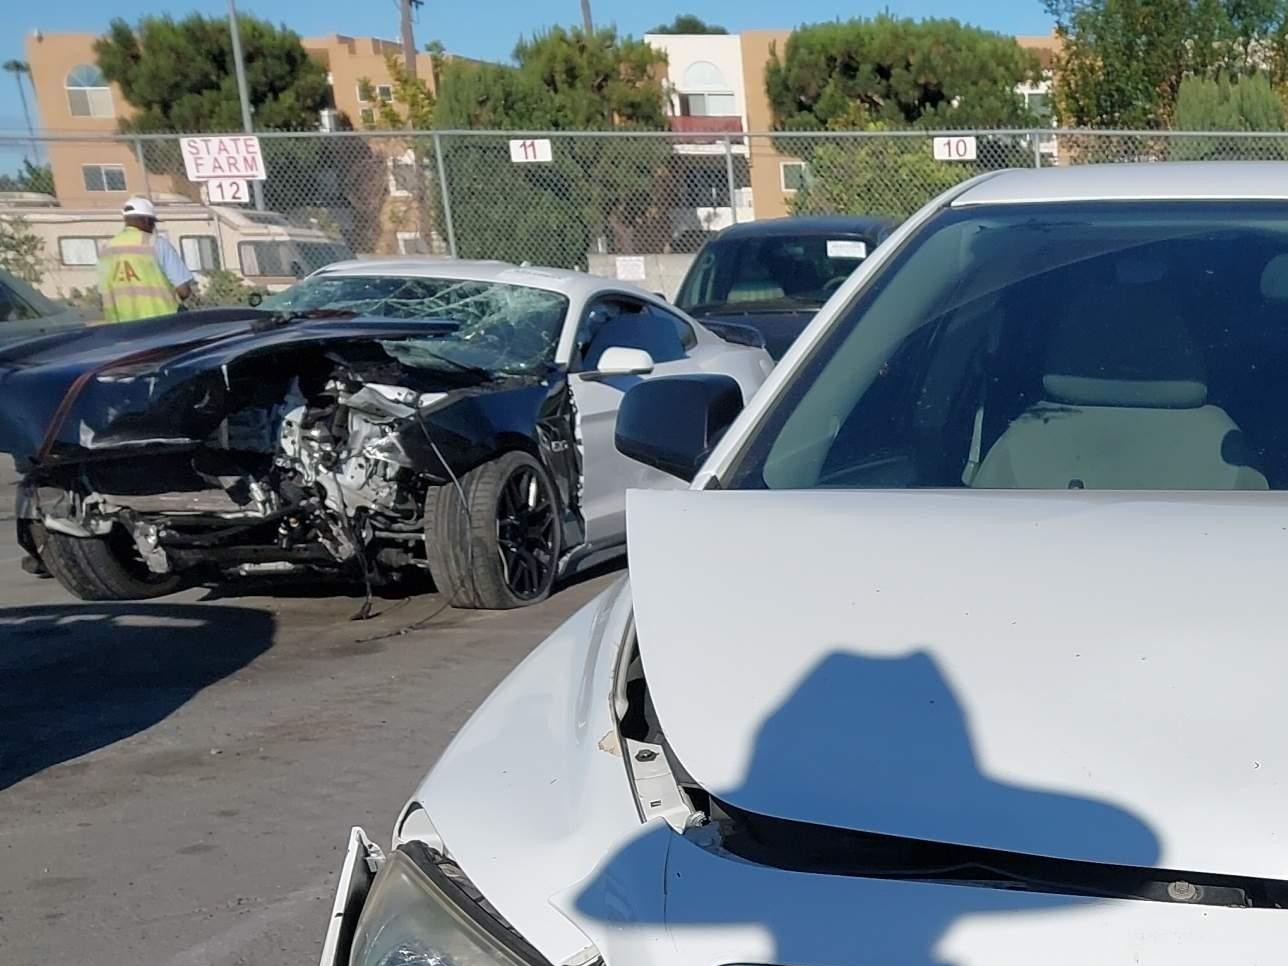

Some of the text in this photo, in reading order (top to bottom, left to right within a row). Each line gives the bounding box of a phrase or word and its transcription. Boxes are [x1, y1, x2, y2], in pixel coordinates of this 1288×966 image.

[187, 138, 258, 156] STATE
[519, 140, 537, 160] 11
[943, 139, 967, 158] 10
[194, 156, 259, 173] FARM
[216, 181, 242, 200] 12
